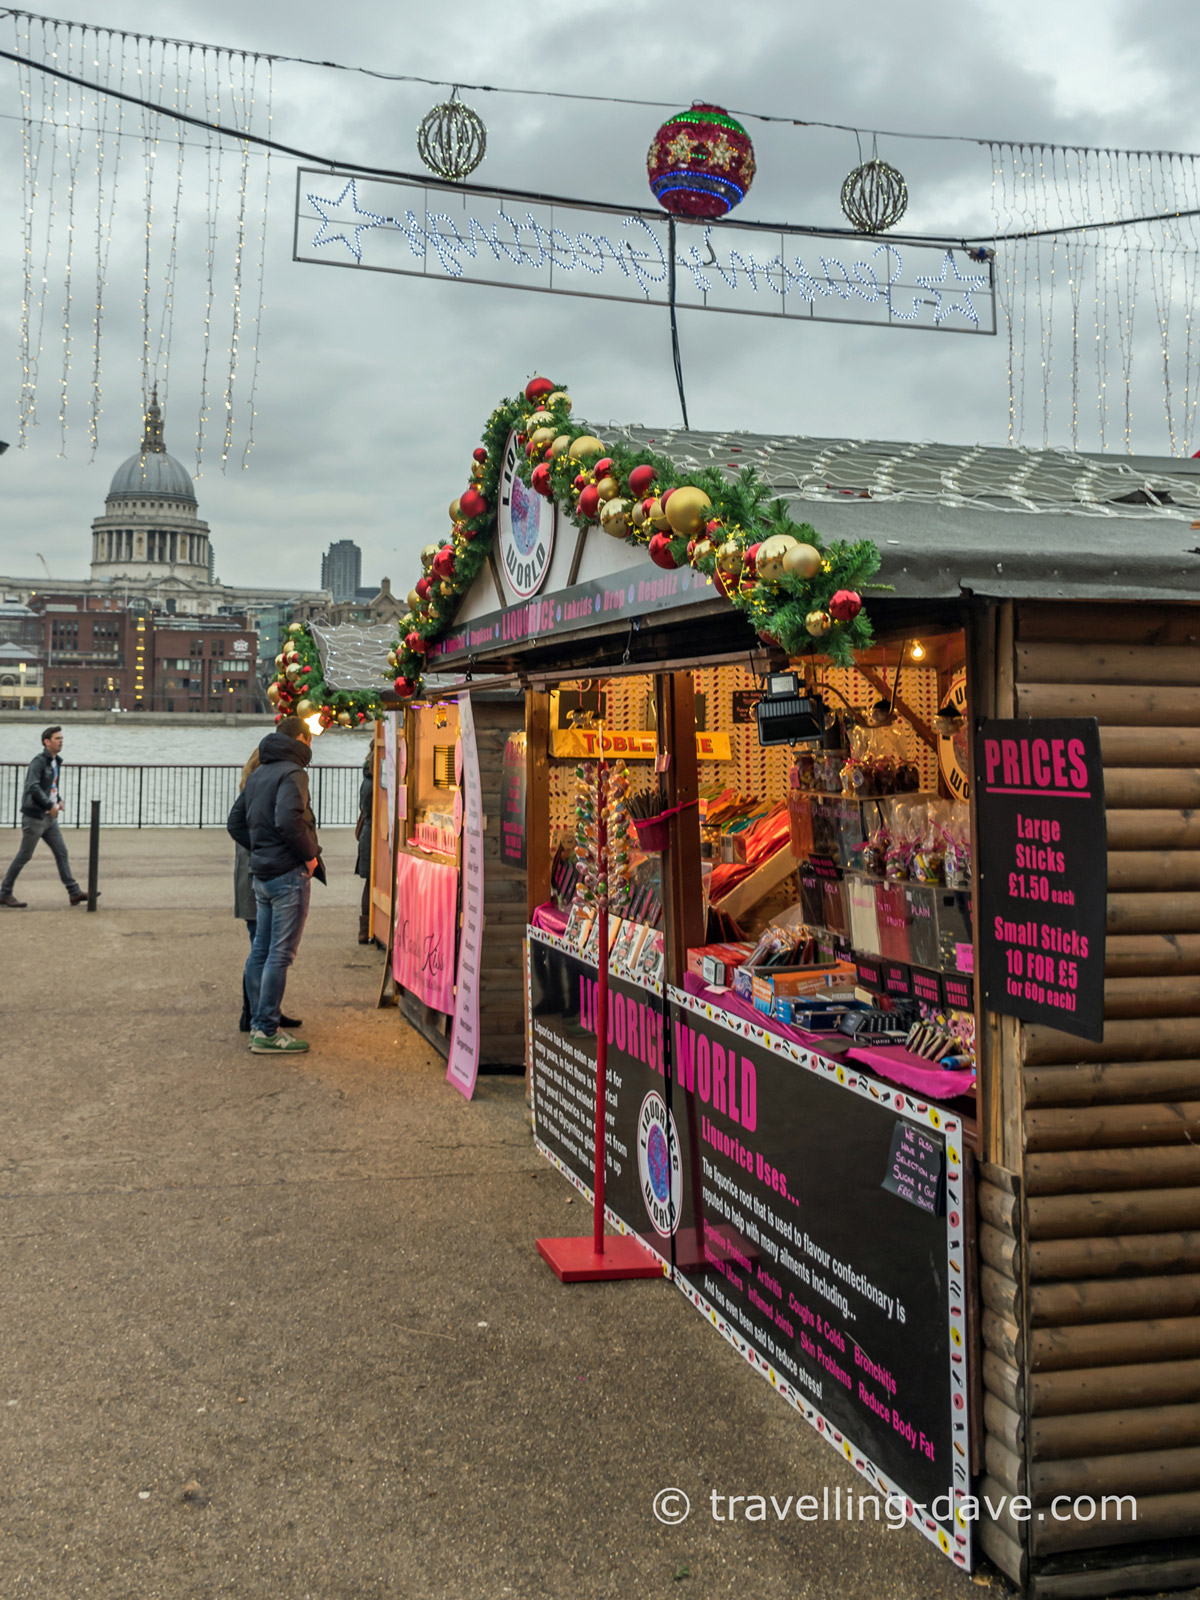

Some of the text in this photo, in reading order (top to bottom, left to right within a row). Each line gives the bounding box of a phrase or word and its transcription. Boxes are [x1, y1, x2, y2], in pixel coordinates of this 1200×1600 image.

[506, 542, 546, 589] WORLD
[502, 598, 555, 641] LIQUORICE
[564, 595, 592, 621] Lakrids
[603, 589, 625, 611] Drop
[637, 572, 678, 602] Regaliz
[582, 733, 713, 754] TOBLEE
[985, 738, 1088, 789] PRICES
[1017, 814, 1060, 843] Large
[1016, 843, 1065, 873] Sticks
[824, 881, 839, 895] COLA
[1009, 872, 1074, 906] £1.50 each
[911, 903, 930, 919] PLAIN
[422, 933, 444, 976] Kiss
[995, 916, 1088, 958] Small Sticks
[945, 980, 968, 995] DOUBLE
[1006, 948, 1023, 976] 10
[1027, 952, 1054, 983] FOR
[1059, 959, 1077, 989] £5
[947, 993, 968, 1007] SALTED
[1007, 977, 1076, 1012] (or 60p each)
[535, 1019, 553, 1041] Liquorice
[553, 1035, 561, 1047] has
[562, 1038, 573, 1055] been
[574, 1049, 587, 1065] eaten
[588, 1058, 597, 1072] and
[613, 1071, 622, 1088] for
[535, 1040, 546, 1057] many
[559, 1055, 564, 1068] in
[565, 1059, 573, 1075] fact
[574, 1066, 586, 1085] there
[587, 1075, 592, 1089] is
[536, 1059, 553, 1079] evidence
[554, 1070, 562, 1086] that
[567, 1080, 575, 1096] has
[576, 1088, 593, 1111] existed
[675, 1021, 756, 1132] WORLD
[559, 1092, 580, 1119] Liquorice
[580, 1109, 585, 1124] is
[586, 1117, 592, 1130] an
[537, 1110, 542, 1124] to
[549, 1121, 560, 1140] times
[560, 1133, 577, 1156] sweeter
[578, 1147, 589, 1167] than
[544, 1101, 553, 1114] root
[553, 1108, 558, 1120] of
[607, 1151, 612, 1167] is
[613, 1159, 622, 1177] up
[613, 1135, 628, 1158] from
[905, 1127, 933, 1152] WE ALSO
[702, 1115, 799, 1207] Liquorice Uses...
[893, 1164, 914, 1187] SUGAR
[896, 1151, 927, 1177] SELECTION
[897, 1184, 913, 1200] FREE
[702, 1156, 906, 1324] The liquorice root that is used to flavour confectionary is
[702, 1186, 856, 1321] reputed to help with many ailments including...
[704, 1274, 715, 1297] And
[715, 1284, 725, 1307] has
[725, 1298, 739, 1321] even
[739, 1307, 754, 1335] been
[754, 1326, 767, 1348] said
[767, 1335, 775, 1354] to
[775, 1345, 798, 1376] reduce
[726, 1238, 752, 1274] Problems
[757, 1265, 782, 1300] Arthritis
[789, 1291, 815, 1328] Coughs
[816, 1314, 822, 1334] &
[824, 1321, 845, 1353] Colds
[854, 1344, 897, 1395] Bronchitis
[726, 1263, 743, 1292] Ulcers
[748, 1283, 774, 1320] Inflamed
[774, 1308, 794, 1339] Joints
[800, 1330, 816, 1358] Skin
[817, 1345, 852, 1390] Problems
[858, 1380, 890, 1423] Reduce
[892, 1409, 917, 1449] Body
[919, 1431, 935, 1462] Fat
